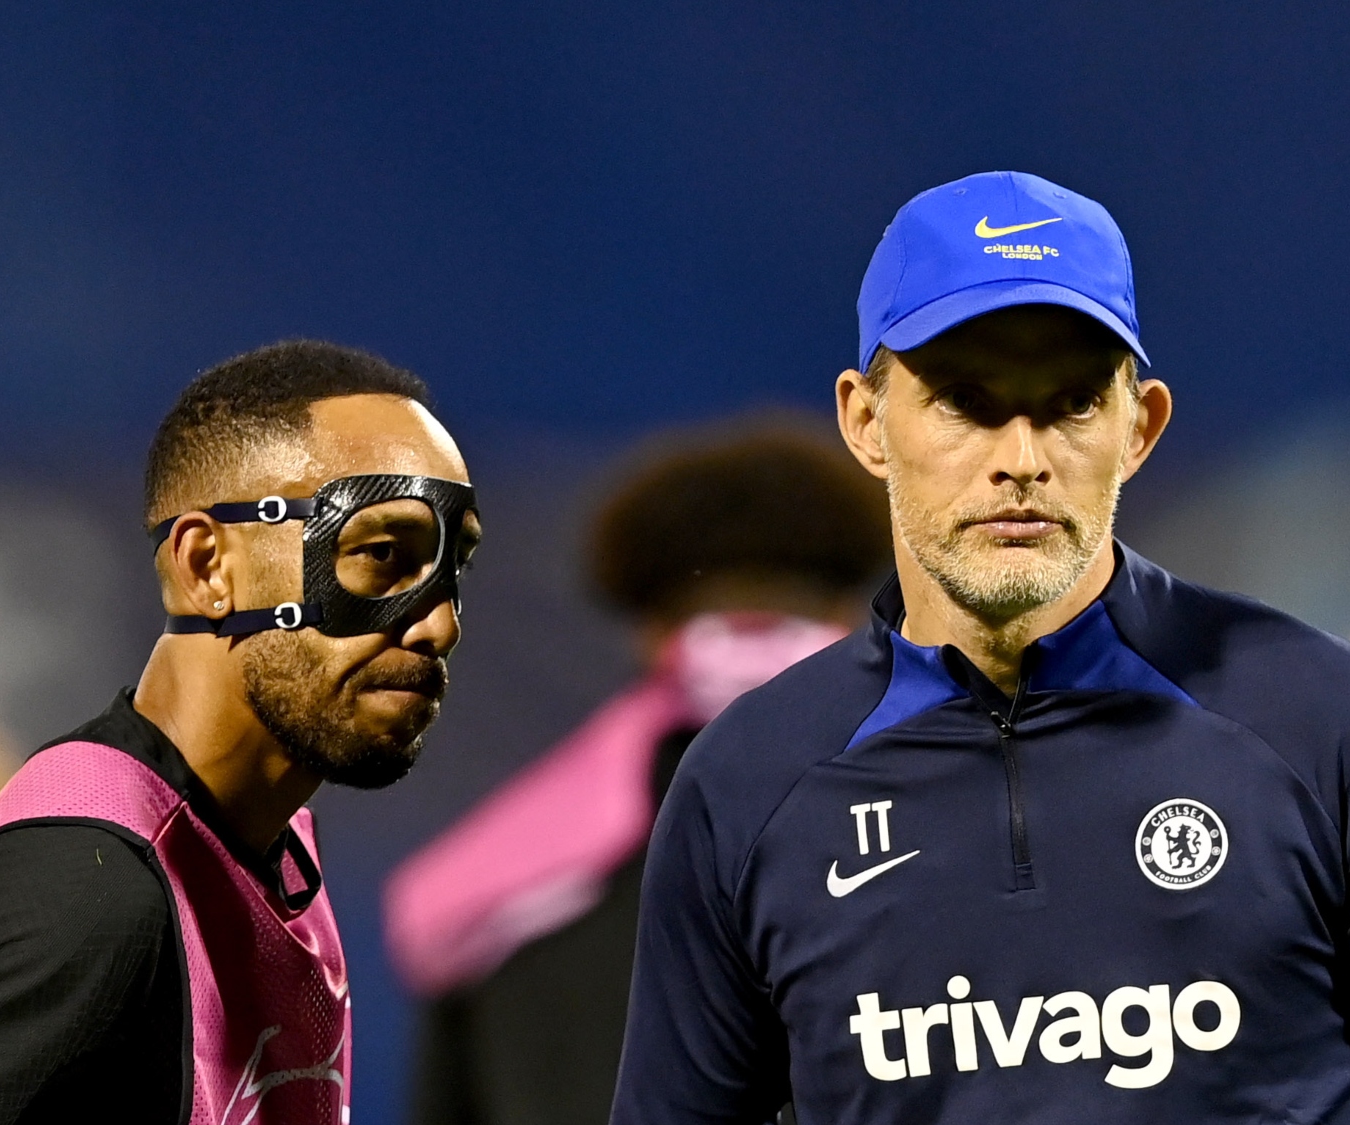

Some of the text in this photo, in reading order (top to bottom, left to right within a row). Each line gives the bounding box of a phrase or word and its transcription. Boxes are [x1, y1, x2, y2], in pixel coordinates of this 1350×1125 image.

[983, 243, 1060, 258] CHELSEA FC
[1002, 252, 1043, 261] LONDON
[1151, 806, 1205, 827] CHELSEA
[850, 800, 892, 855] TT
[1155, 865, 1212, 883] FOOTBALL CLUB
[849, 975, 1241, 1089] trivago
